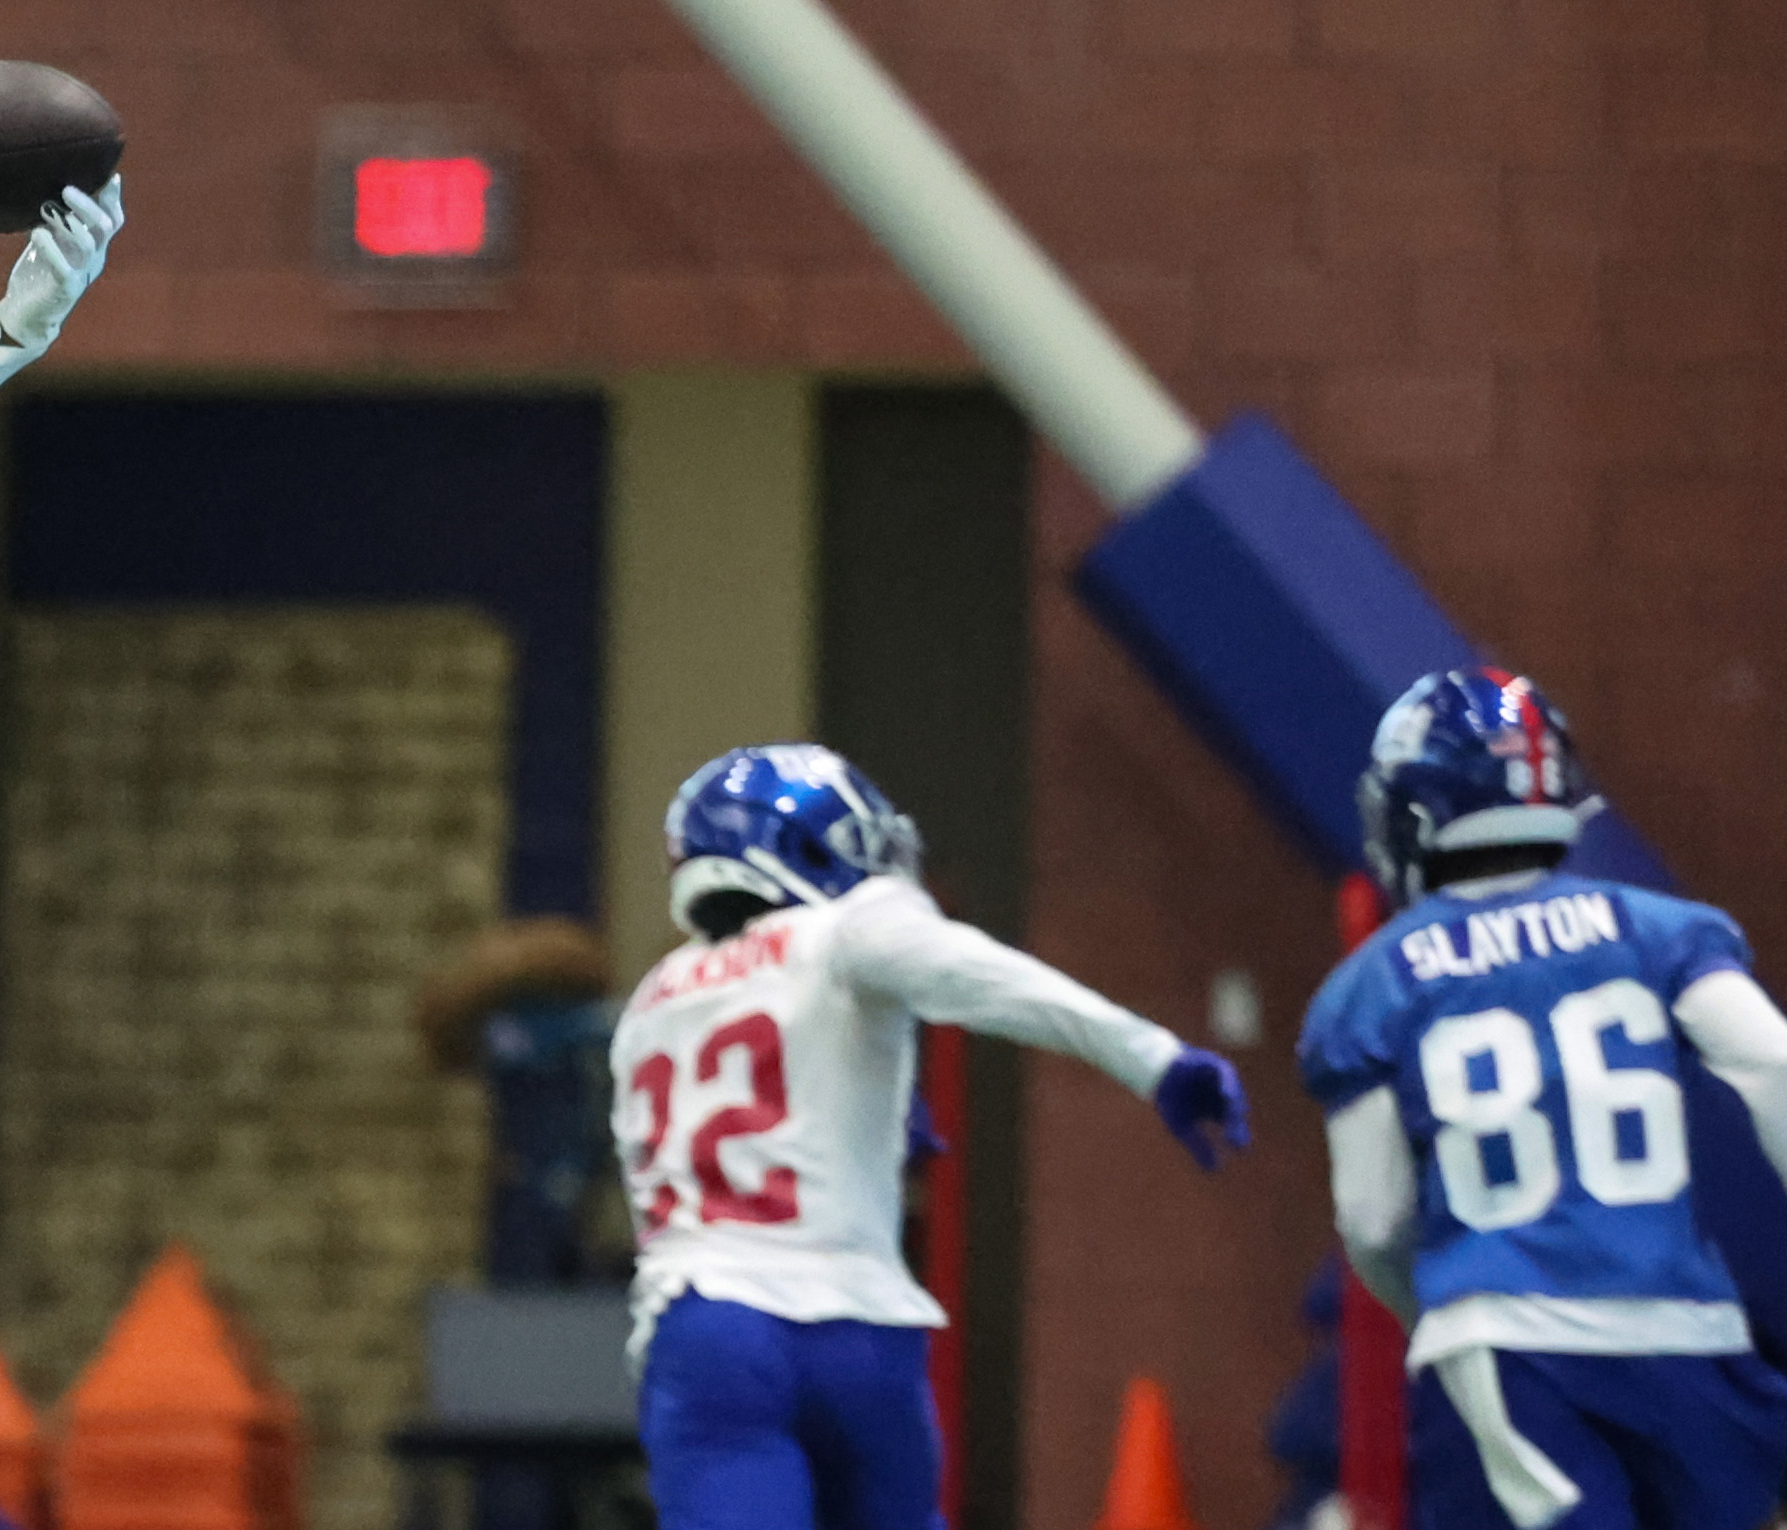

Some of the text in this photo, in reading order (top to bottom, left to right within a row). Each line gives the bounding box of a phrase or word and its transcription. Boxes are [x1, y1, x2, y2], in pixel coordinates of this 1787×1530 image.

[1401, 890, 1620, 982] SLAYTON
[631, 1010, 798, 1242] 22
[1418, 977, 1691, 1234] 86
